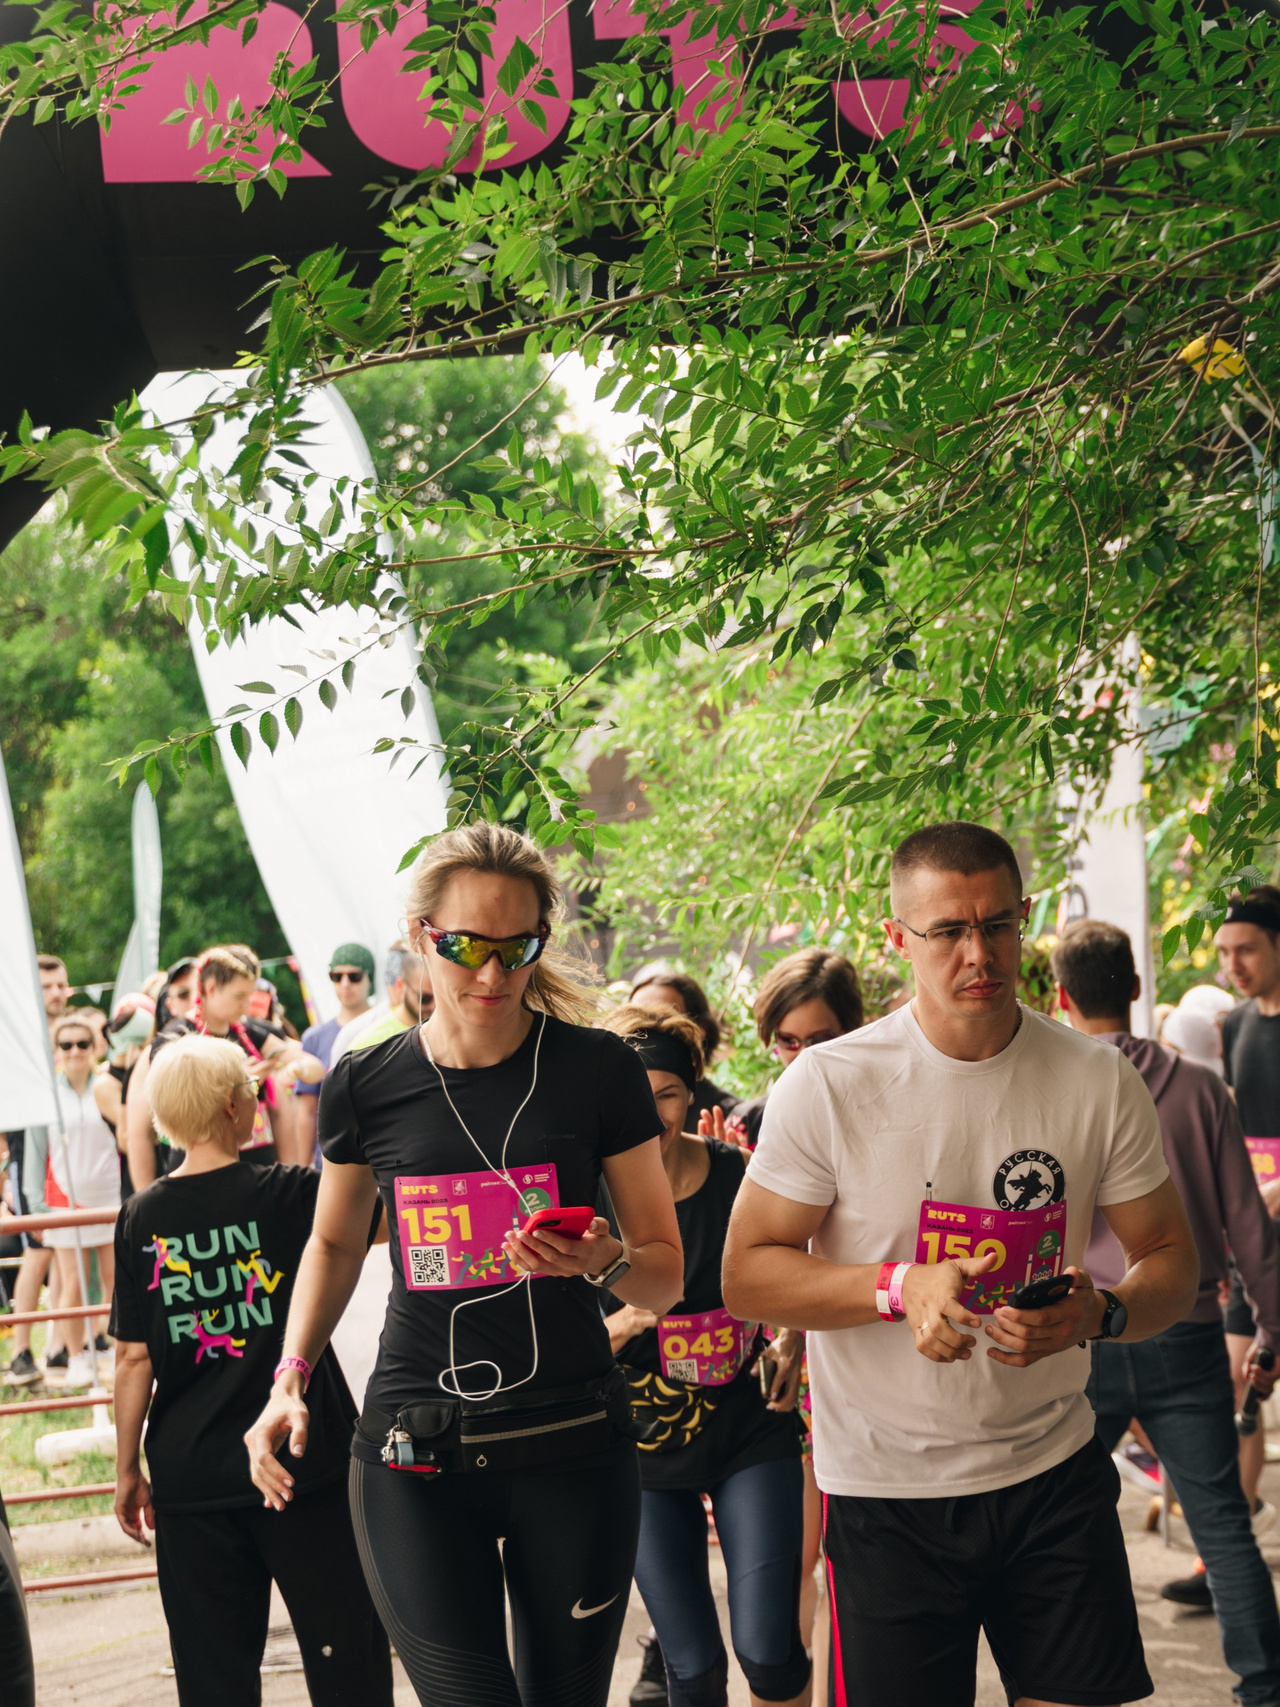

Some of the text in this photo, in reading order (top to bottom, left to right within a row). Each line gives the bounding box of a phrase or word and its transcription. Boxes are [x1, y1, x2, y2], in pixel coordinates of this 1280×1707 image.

[998, 1150, 1062, 1176] РУССКАЯ
[401, 1184, 439, 1196] RUTS
[526, 1192, 540, 1207] 2
[401, 1204, 473, 1244] 151
[928, 1209, 966, 1223] RUTS
[155, 1220, 260, 1268] RUN
[1042, 1235, 1053, 1248] 2
[167, 1297, 273, 1344] RUN
[662, 1320, 692, 1329] RUTS
[663, 1325, 735, 1360] 043
